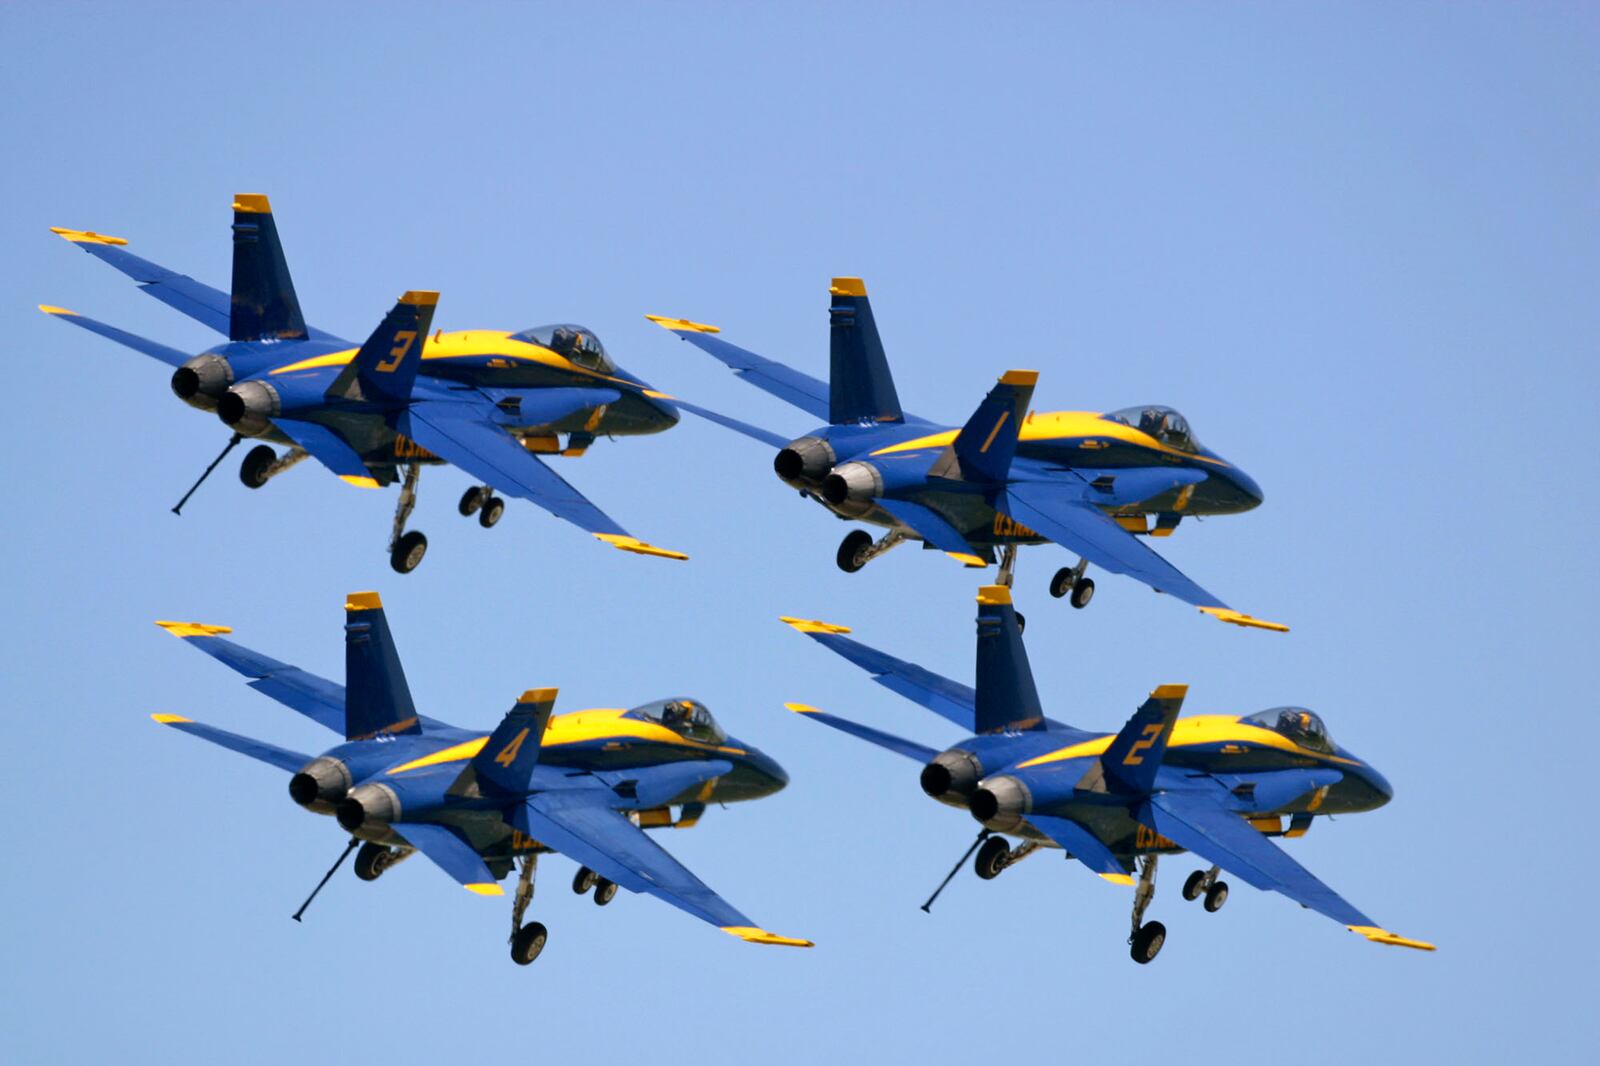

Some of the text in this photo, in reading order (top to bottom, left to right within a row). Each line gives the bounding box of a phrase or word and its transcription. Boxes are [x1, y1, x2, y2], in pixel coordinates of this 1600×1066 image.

[375, 331, 417, 372] 3
[980, 411, 1008, 452] 1
[495, 727, 529, 768] 4
[1122, 723, 1165, 765] 2
